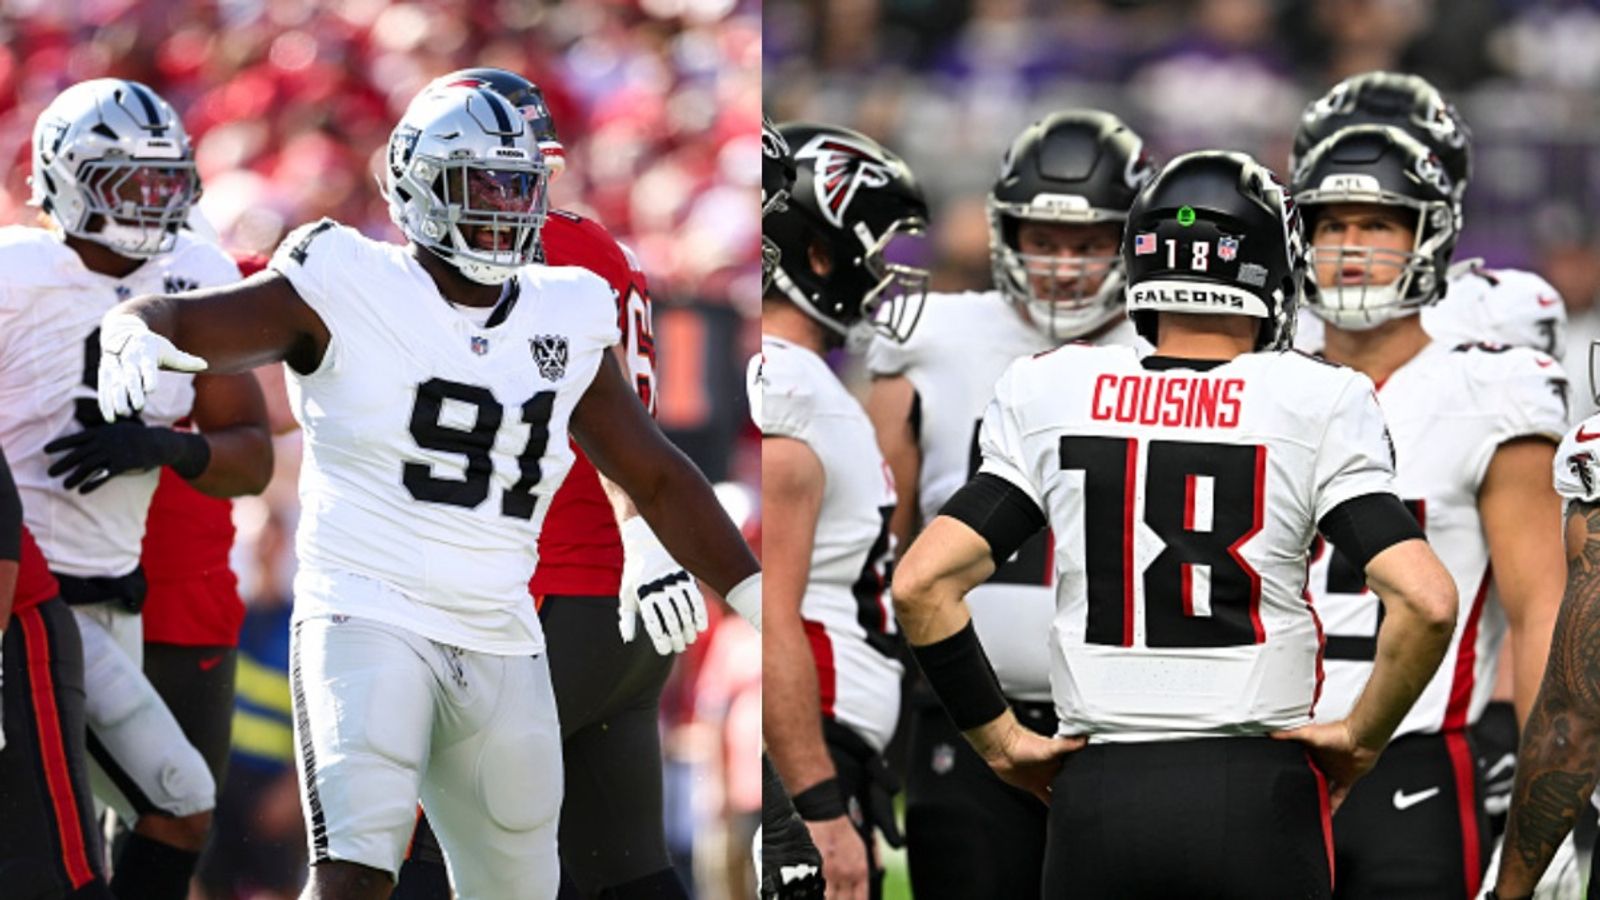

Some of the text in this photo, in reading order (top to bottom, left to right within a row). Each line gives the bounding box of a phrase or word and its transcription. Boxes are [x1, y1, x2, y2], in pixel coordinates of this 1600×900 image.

[1134, 289, 1244, 309] FALCONS
[402, 377, 556, 521] 91
[1091, 374, 1245, 428] COUSINS
[1059, 435, 1268, 648] 18
